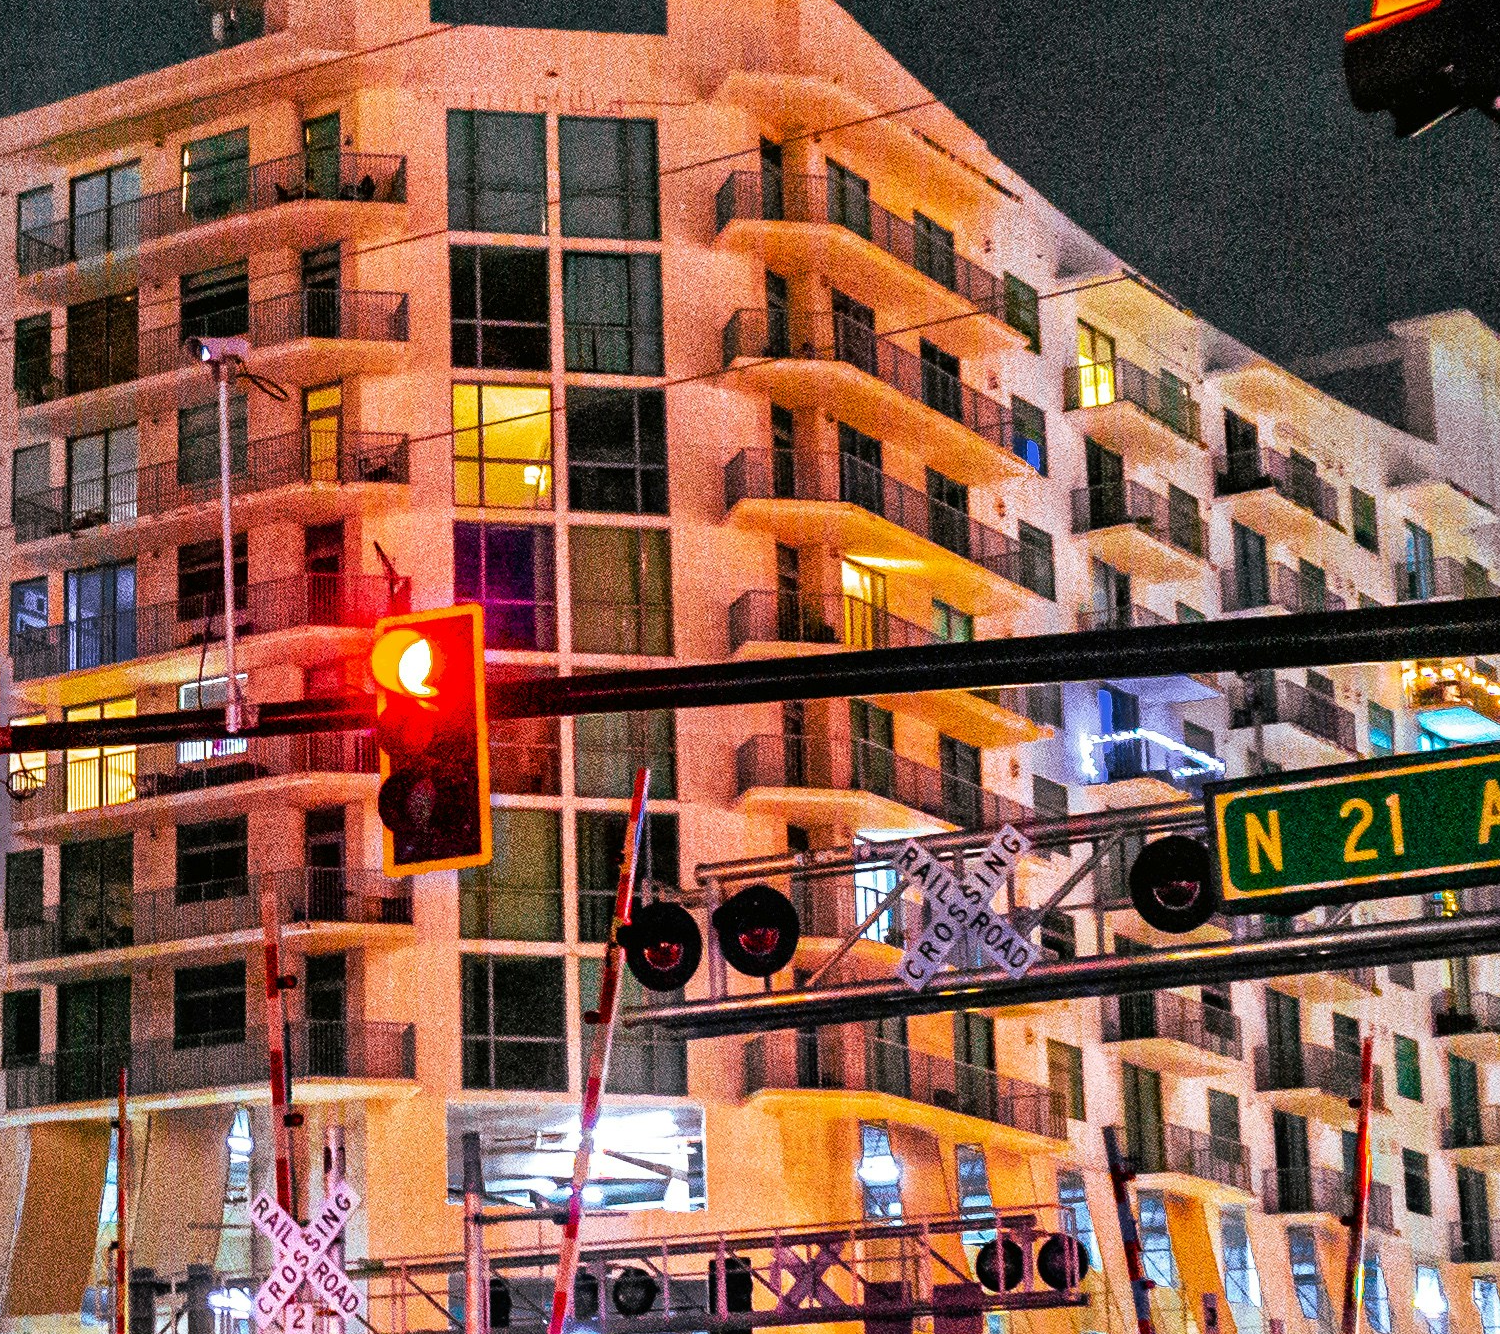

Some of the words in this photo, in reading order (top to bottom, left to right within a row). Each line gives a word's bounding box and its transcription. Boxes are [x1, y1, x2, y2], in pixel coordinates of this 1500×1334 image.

[1244, 809, 1284, 874] N
[1339, 793, 1405, 863] 21
[899, 847, 950, 904] RAIL
[970, 911, 1028, 968] ROAD
[904, 834, 1021, 979] CROSSING
[253, 1197, 294, 1249] RAIL
[313, 1261, 359, 1315] ROAD
[258, 1193, 351, 1314] CROSSING
[292, 1305, 305, 1330] 2
